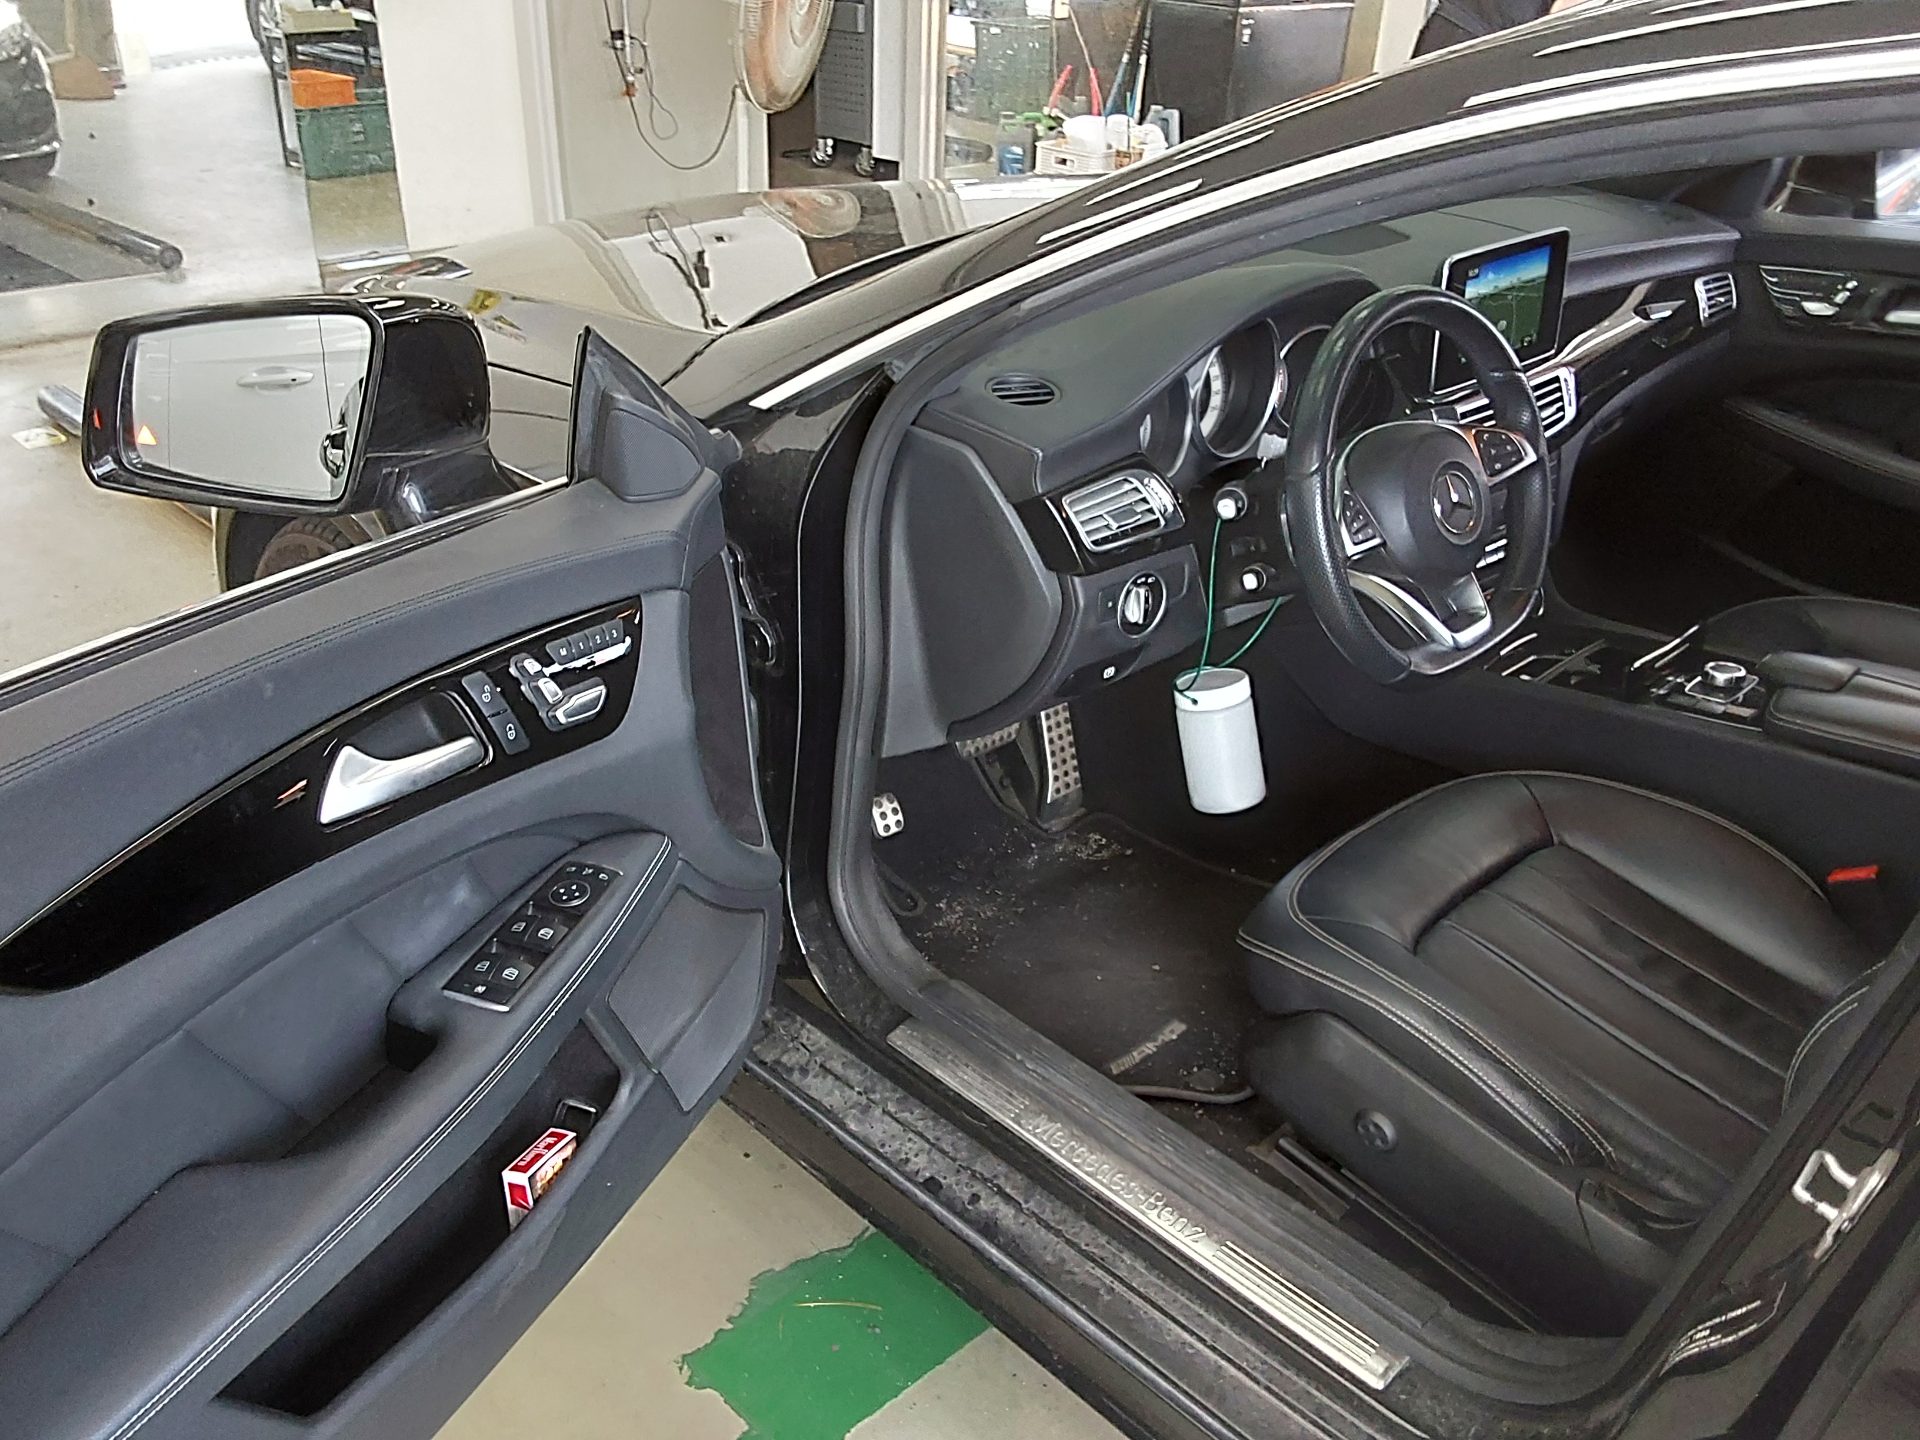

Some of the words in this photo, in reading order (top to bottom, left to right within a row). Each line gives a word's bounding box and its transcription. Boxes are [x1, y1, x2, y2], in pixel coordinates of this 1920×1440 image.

[595, 635, 602, 644] 2
[611, 629, 618, 638] 3
[1028, 1113, 1207, 1243] Mercedes-Benz
